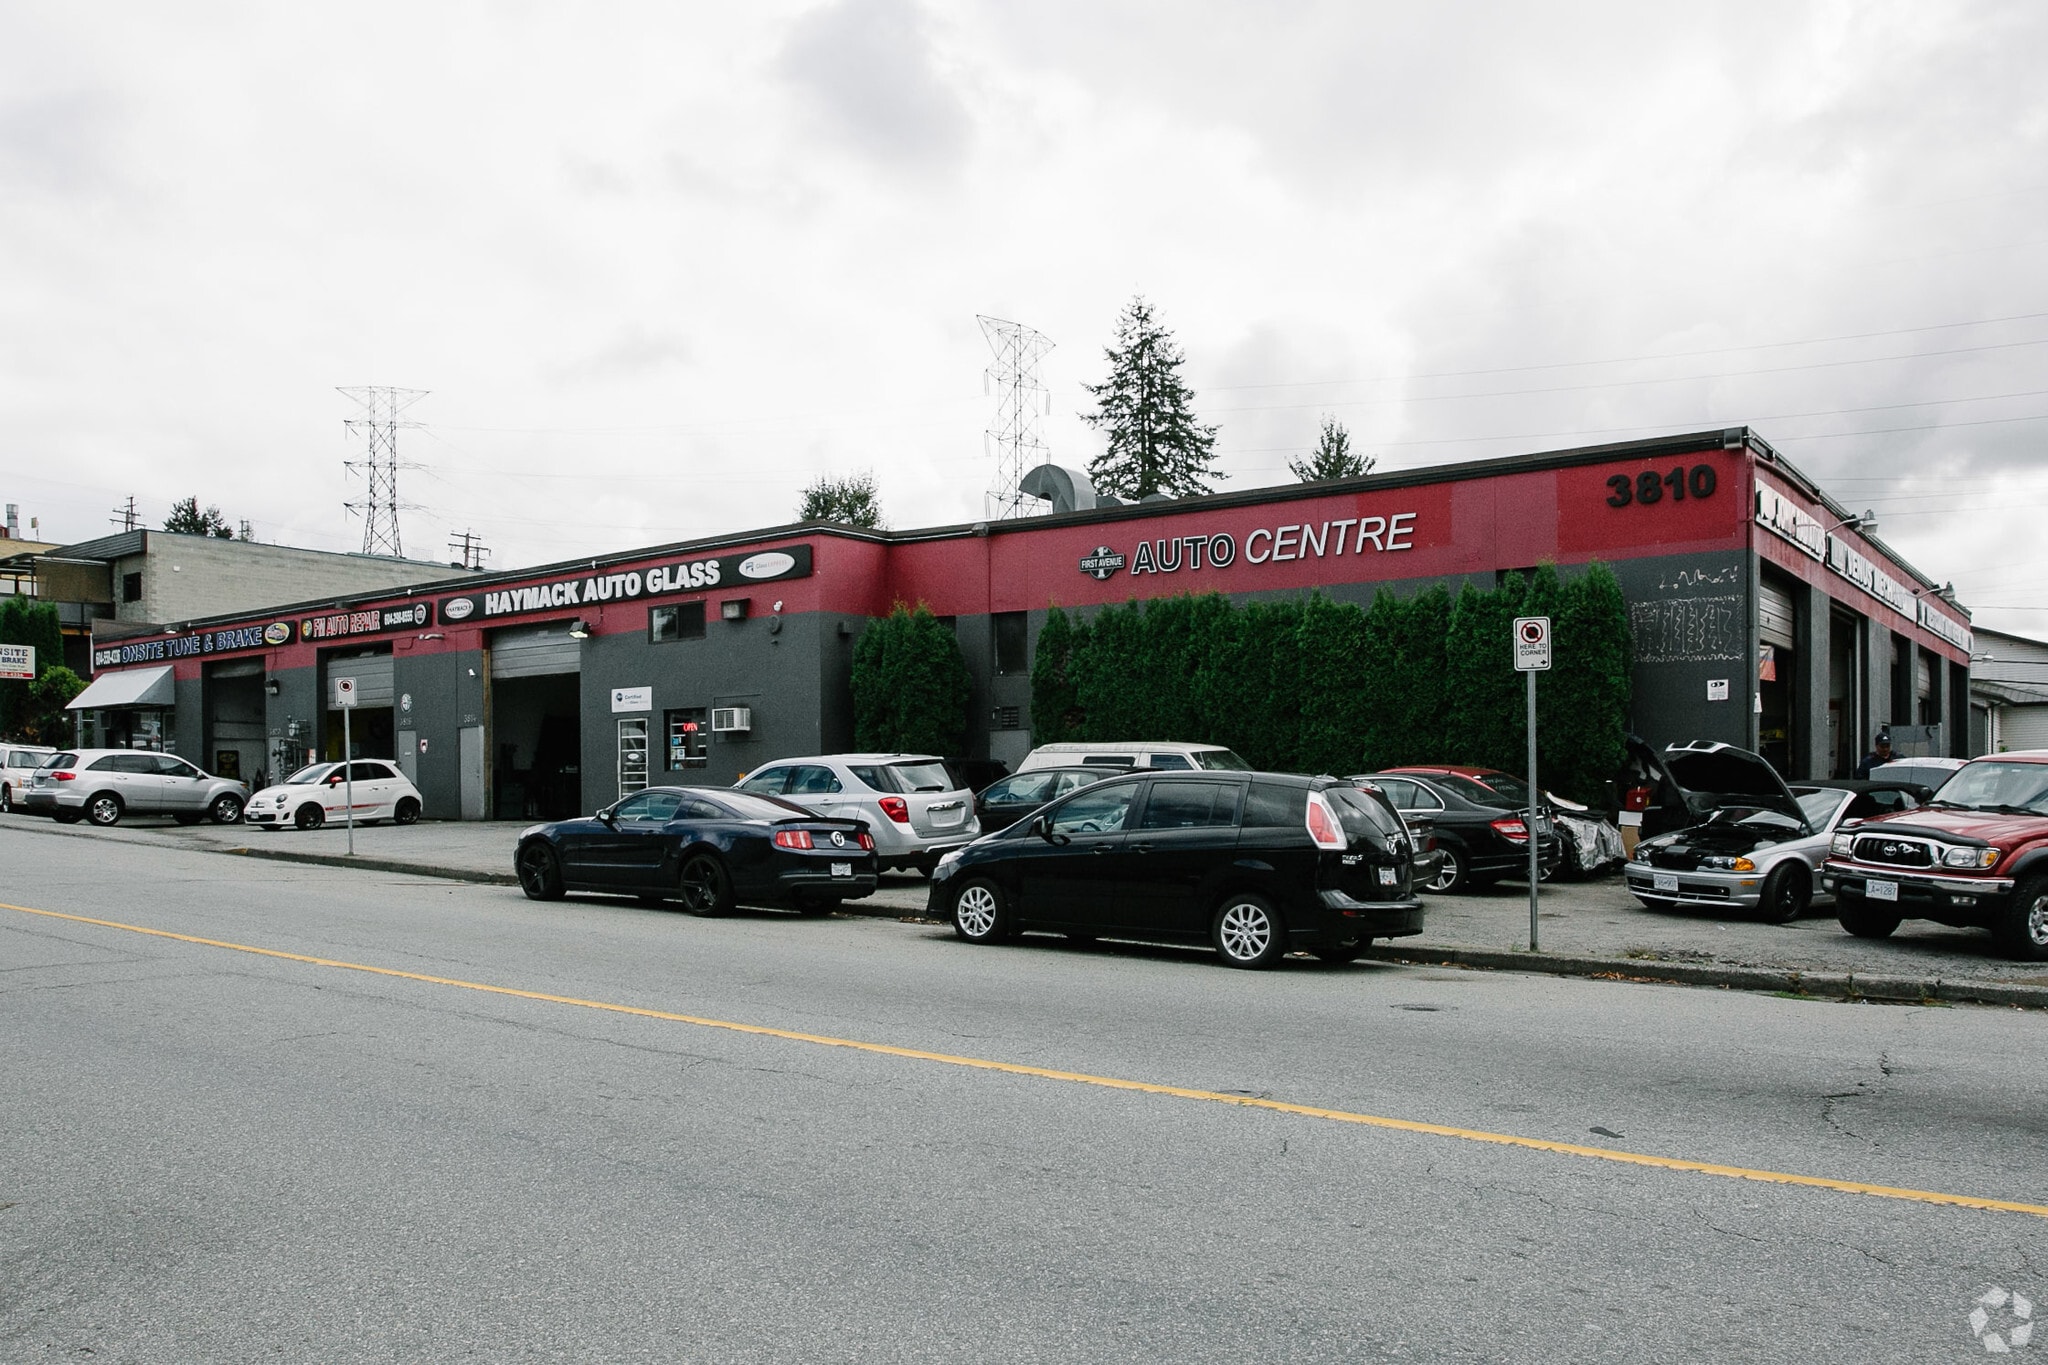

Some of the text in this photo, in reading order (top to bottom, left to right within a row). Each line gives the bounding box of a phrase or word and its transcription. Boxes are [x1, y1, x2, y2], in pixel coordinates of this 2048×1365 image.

[1606, 464, 1716, 508] 3810
[1131, 512, 1417, 575] AUTO CENTRE
[1081, 556, 1122, 569] FIRST AVENUE
[485, 559, 721, 615] HAYMACK AUTO GLASS
[326, 614, 349, 635] AUTO
[350, 610, 380, 633] REPAIR
[121, 641, 164, 663] ONSITE
[166, 635, 200, 657] TUNE
[203, 633, 214, 652] &
[217, 626, 262, 650] BRAKE
[683, 722, 698, 732] OPEN
